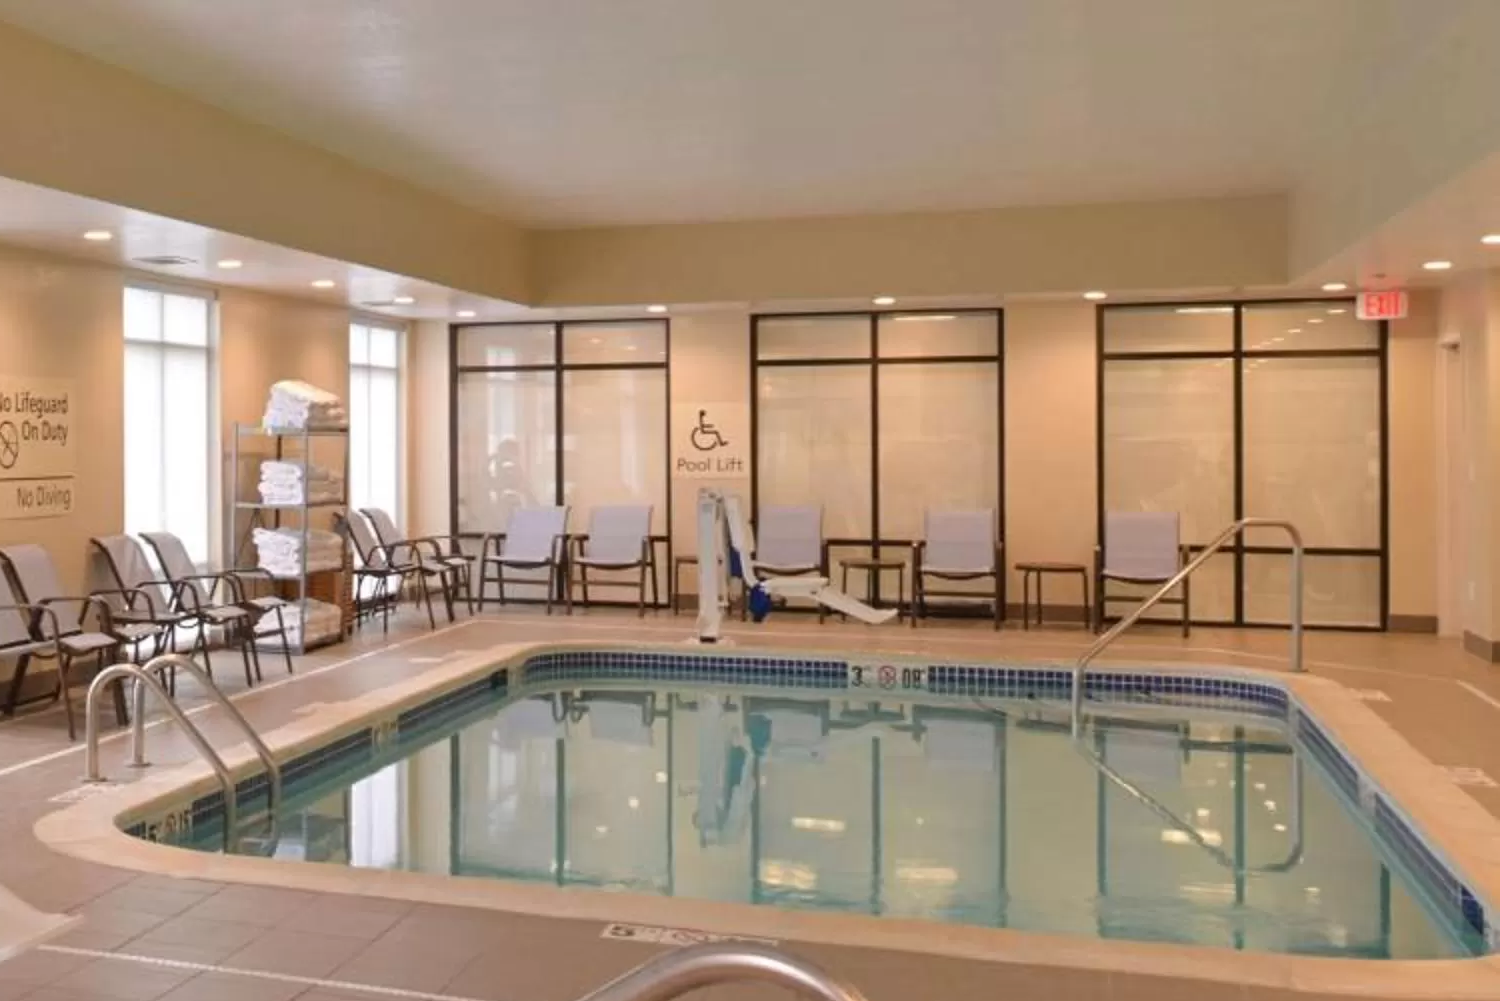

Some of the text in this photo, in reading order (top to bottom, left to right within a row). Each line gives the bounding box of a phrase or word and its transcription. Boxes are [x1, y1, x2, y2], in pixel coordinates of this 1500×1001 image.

[1364, 292, 1400, 318] EXIT
[15, 391, 69, 419] Lifeguard
[21, 419, 68, 447] On Duty
[677, 456, 744, 472] Pool Lift
[16, 484, 71, 511] No Diving
